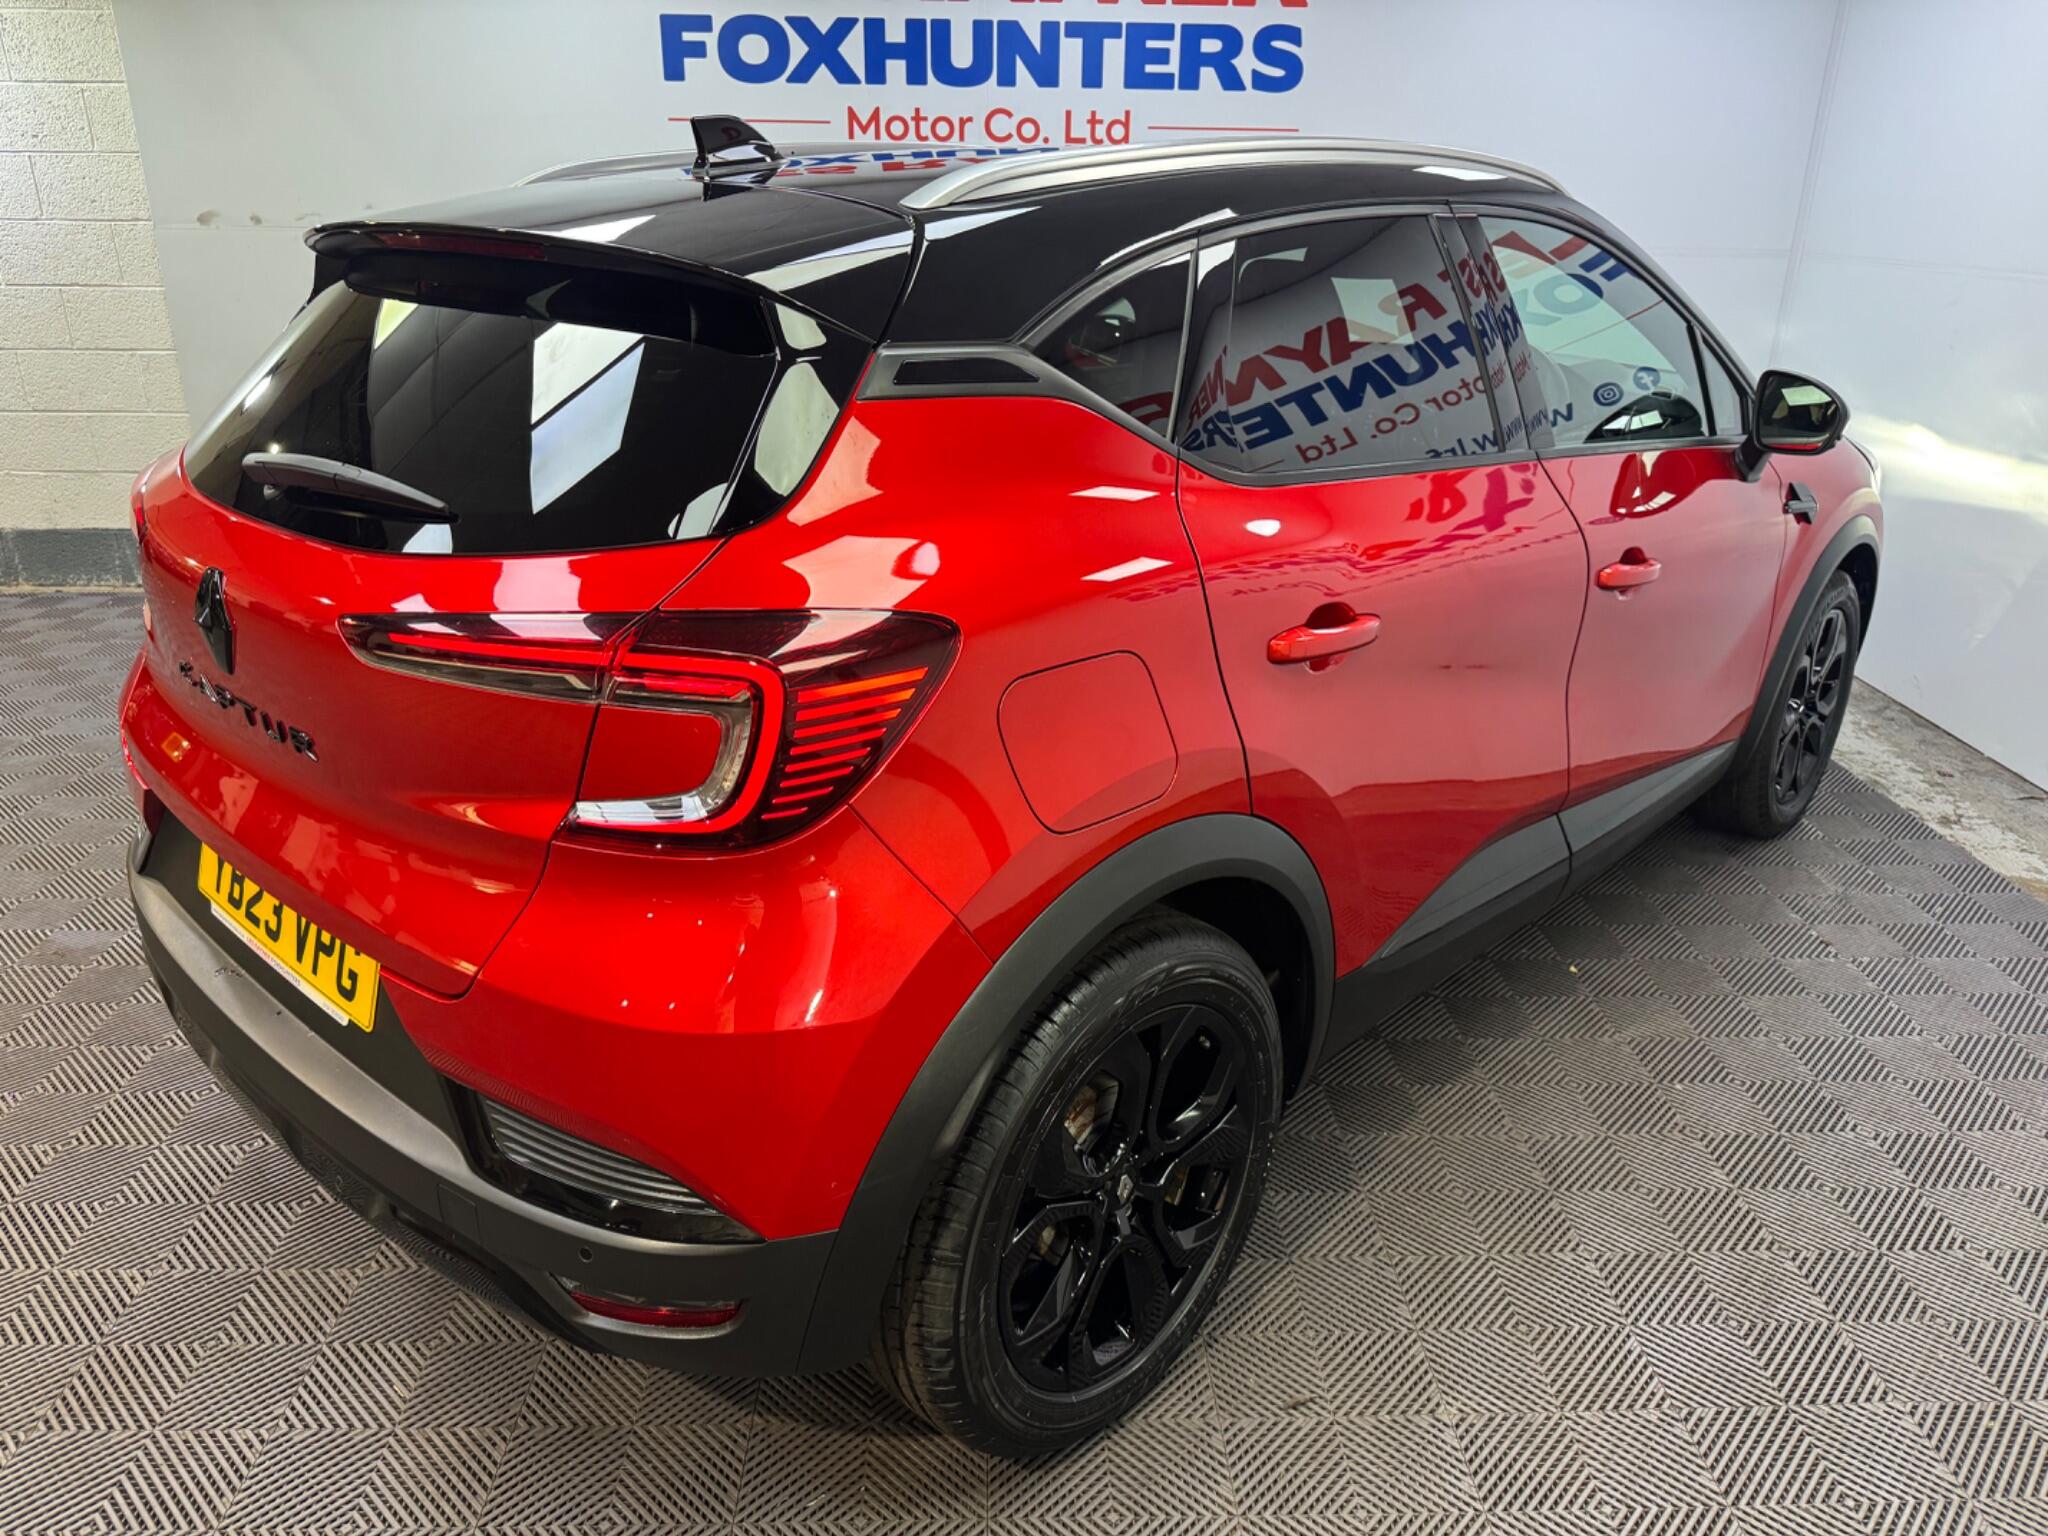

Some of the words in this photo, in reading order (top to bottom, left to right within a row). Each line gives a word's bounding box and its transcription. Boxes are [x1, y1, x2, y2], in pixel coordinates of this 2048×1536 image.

[659, 13, 1304, 93] FOXHUNTERS
[847, 105, 973, 143] Motor
[984, 107, 1050, 144] Co.
[1064, 109, 1131, 145] Ltd
[215, 854, 285, 944] YB23
[295, 912, 360, 1003] VPG
